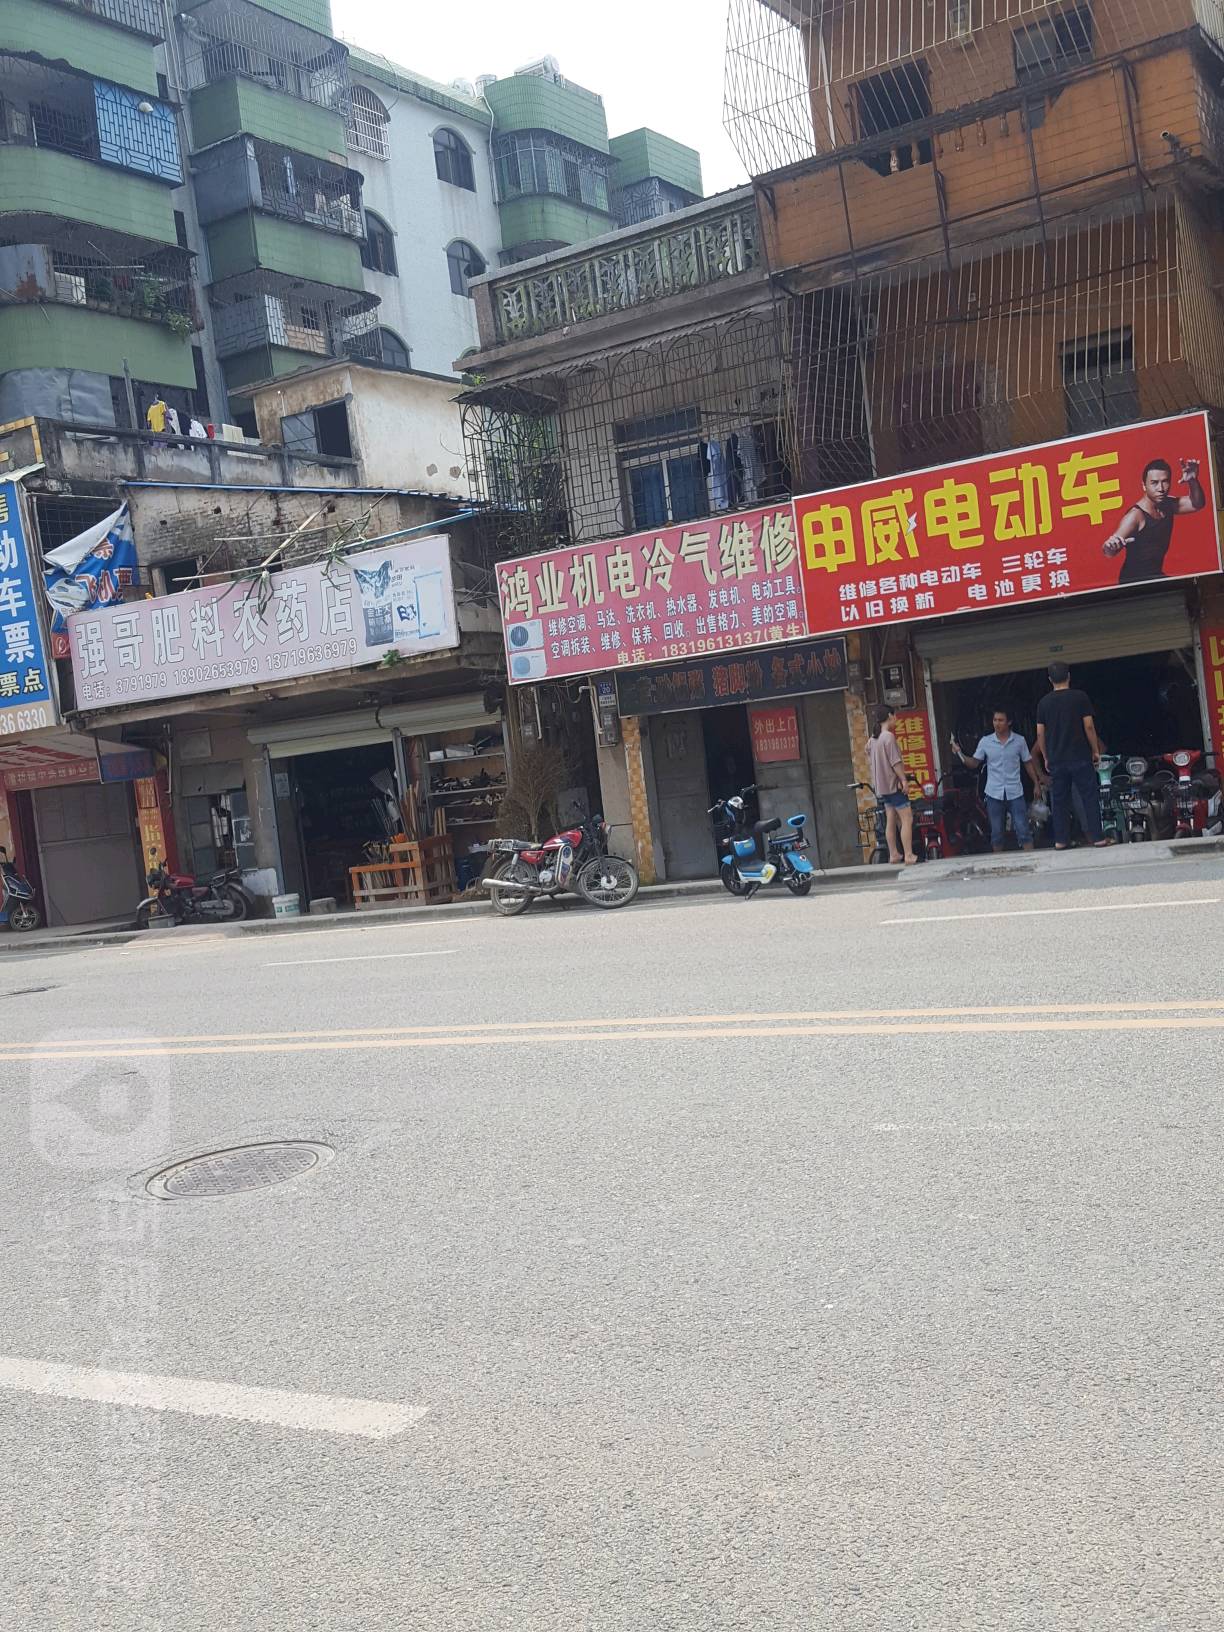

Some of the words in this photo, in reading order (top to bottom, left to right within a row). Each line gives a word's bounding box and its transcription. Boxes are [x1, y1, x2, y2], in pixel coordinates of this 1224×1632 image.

[802, 451, 1124, 573] 申威电动车
[501, 512, 797, 620] 鸿业机电冷气维修
[838, 562, 982, 601] 维修各种电动车
[1001, 547, 1068, 575] 三轮车
[840, 590, 936, 623] 以旧换新
[967, 570, 1071, 602] 电池更换
[74, 569, 354, 680] 强哥肥料农药店
[173, 656, 259, 686] 18902653979
[266, 638, 358, 670] 13719636979
[17, 707, 47, 731] 6330
